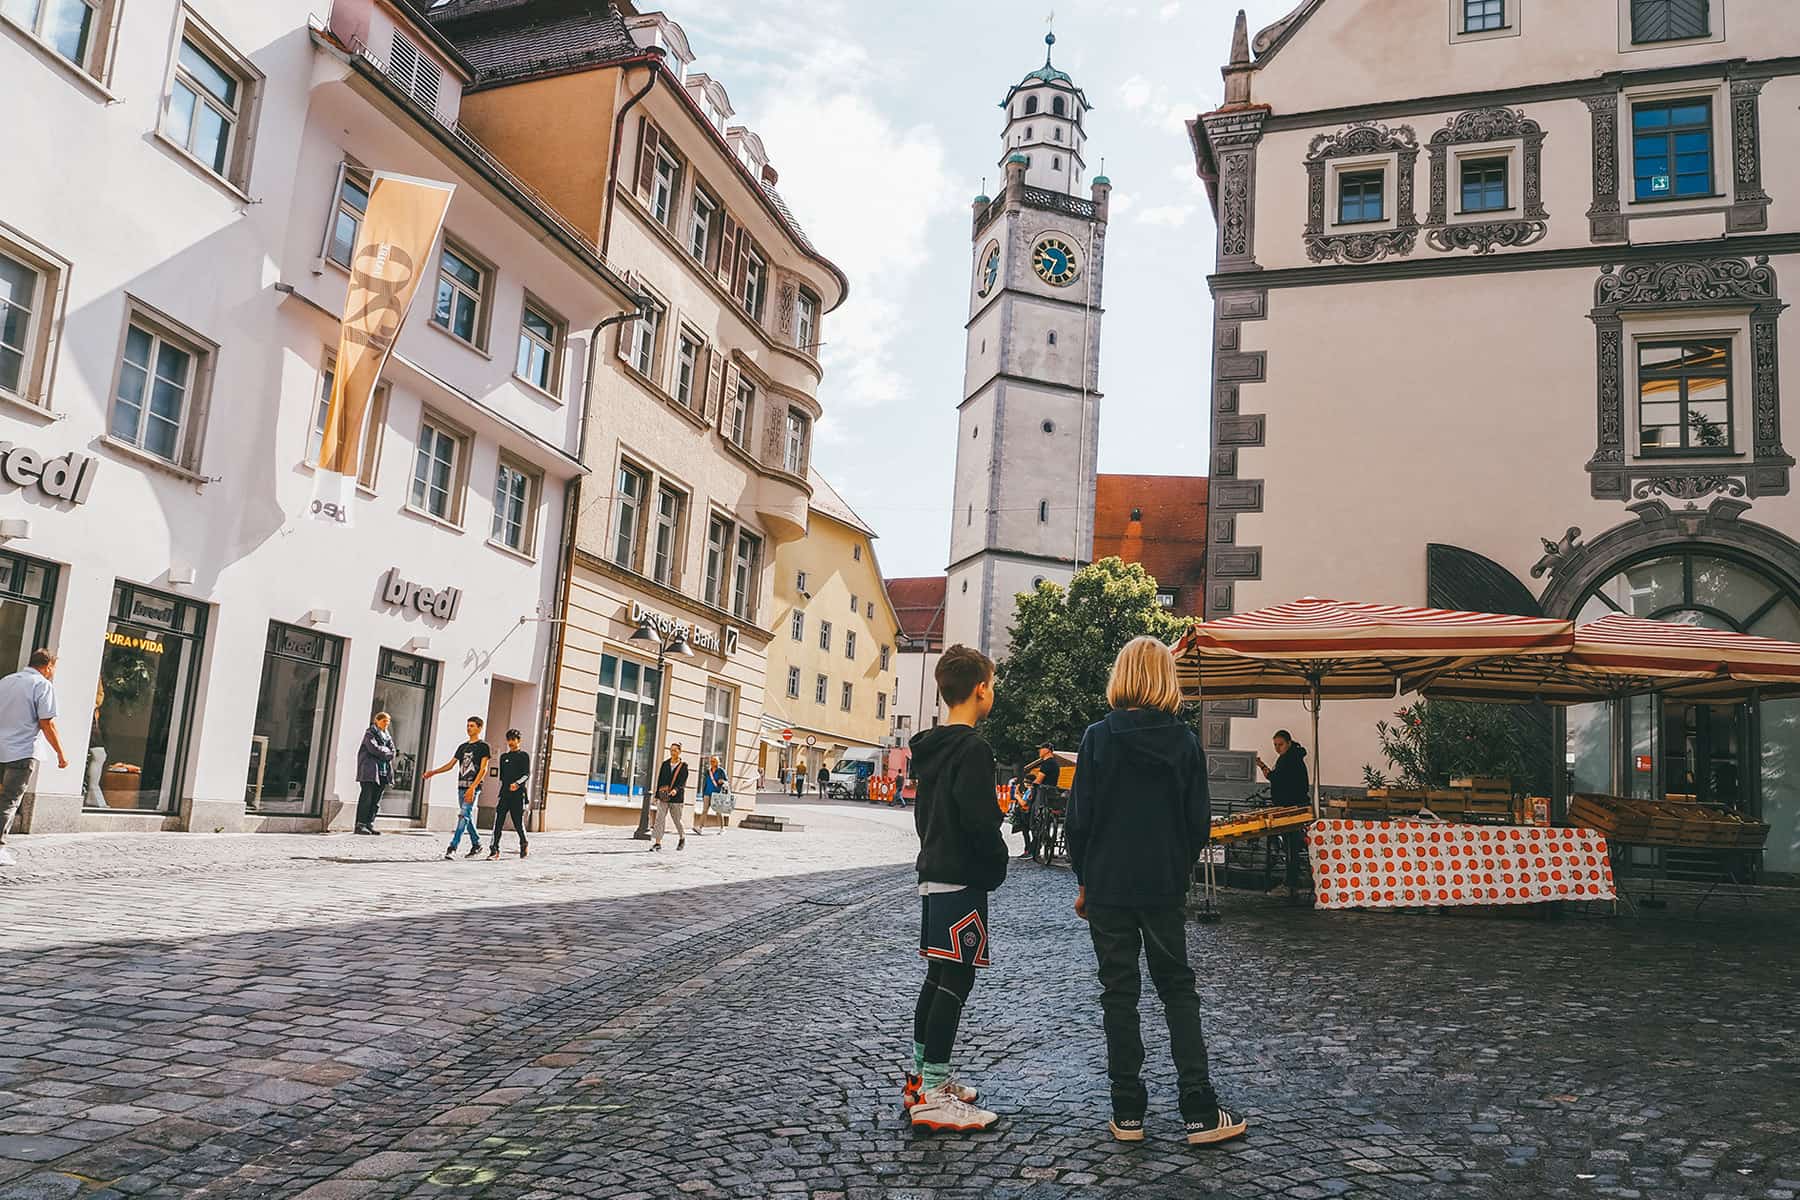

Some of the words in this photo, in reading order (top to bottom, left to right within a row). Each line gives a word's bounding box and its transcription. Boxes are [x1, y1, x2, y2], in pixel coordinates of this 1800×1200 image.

[0, 440, 99, 505] edl
[385, 567, 462, 621] bredl
[140, 639, 164, 654] VIDA
[693, 624, 720, 652] Bank
